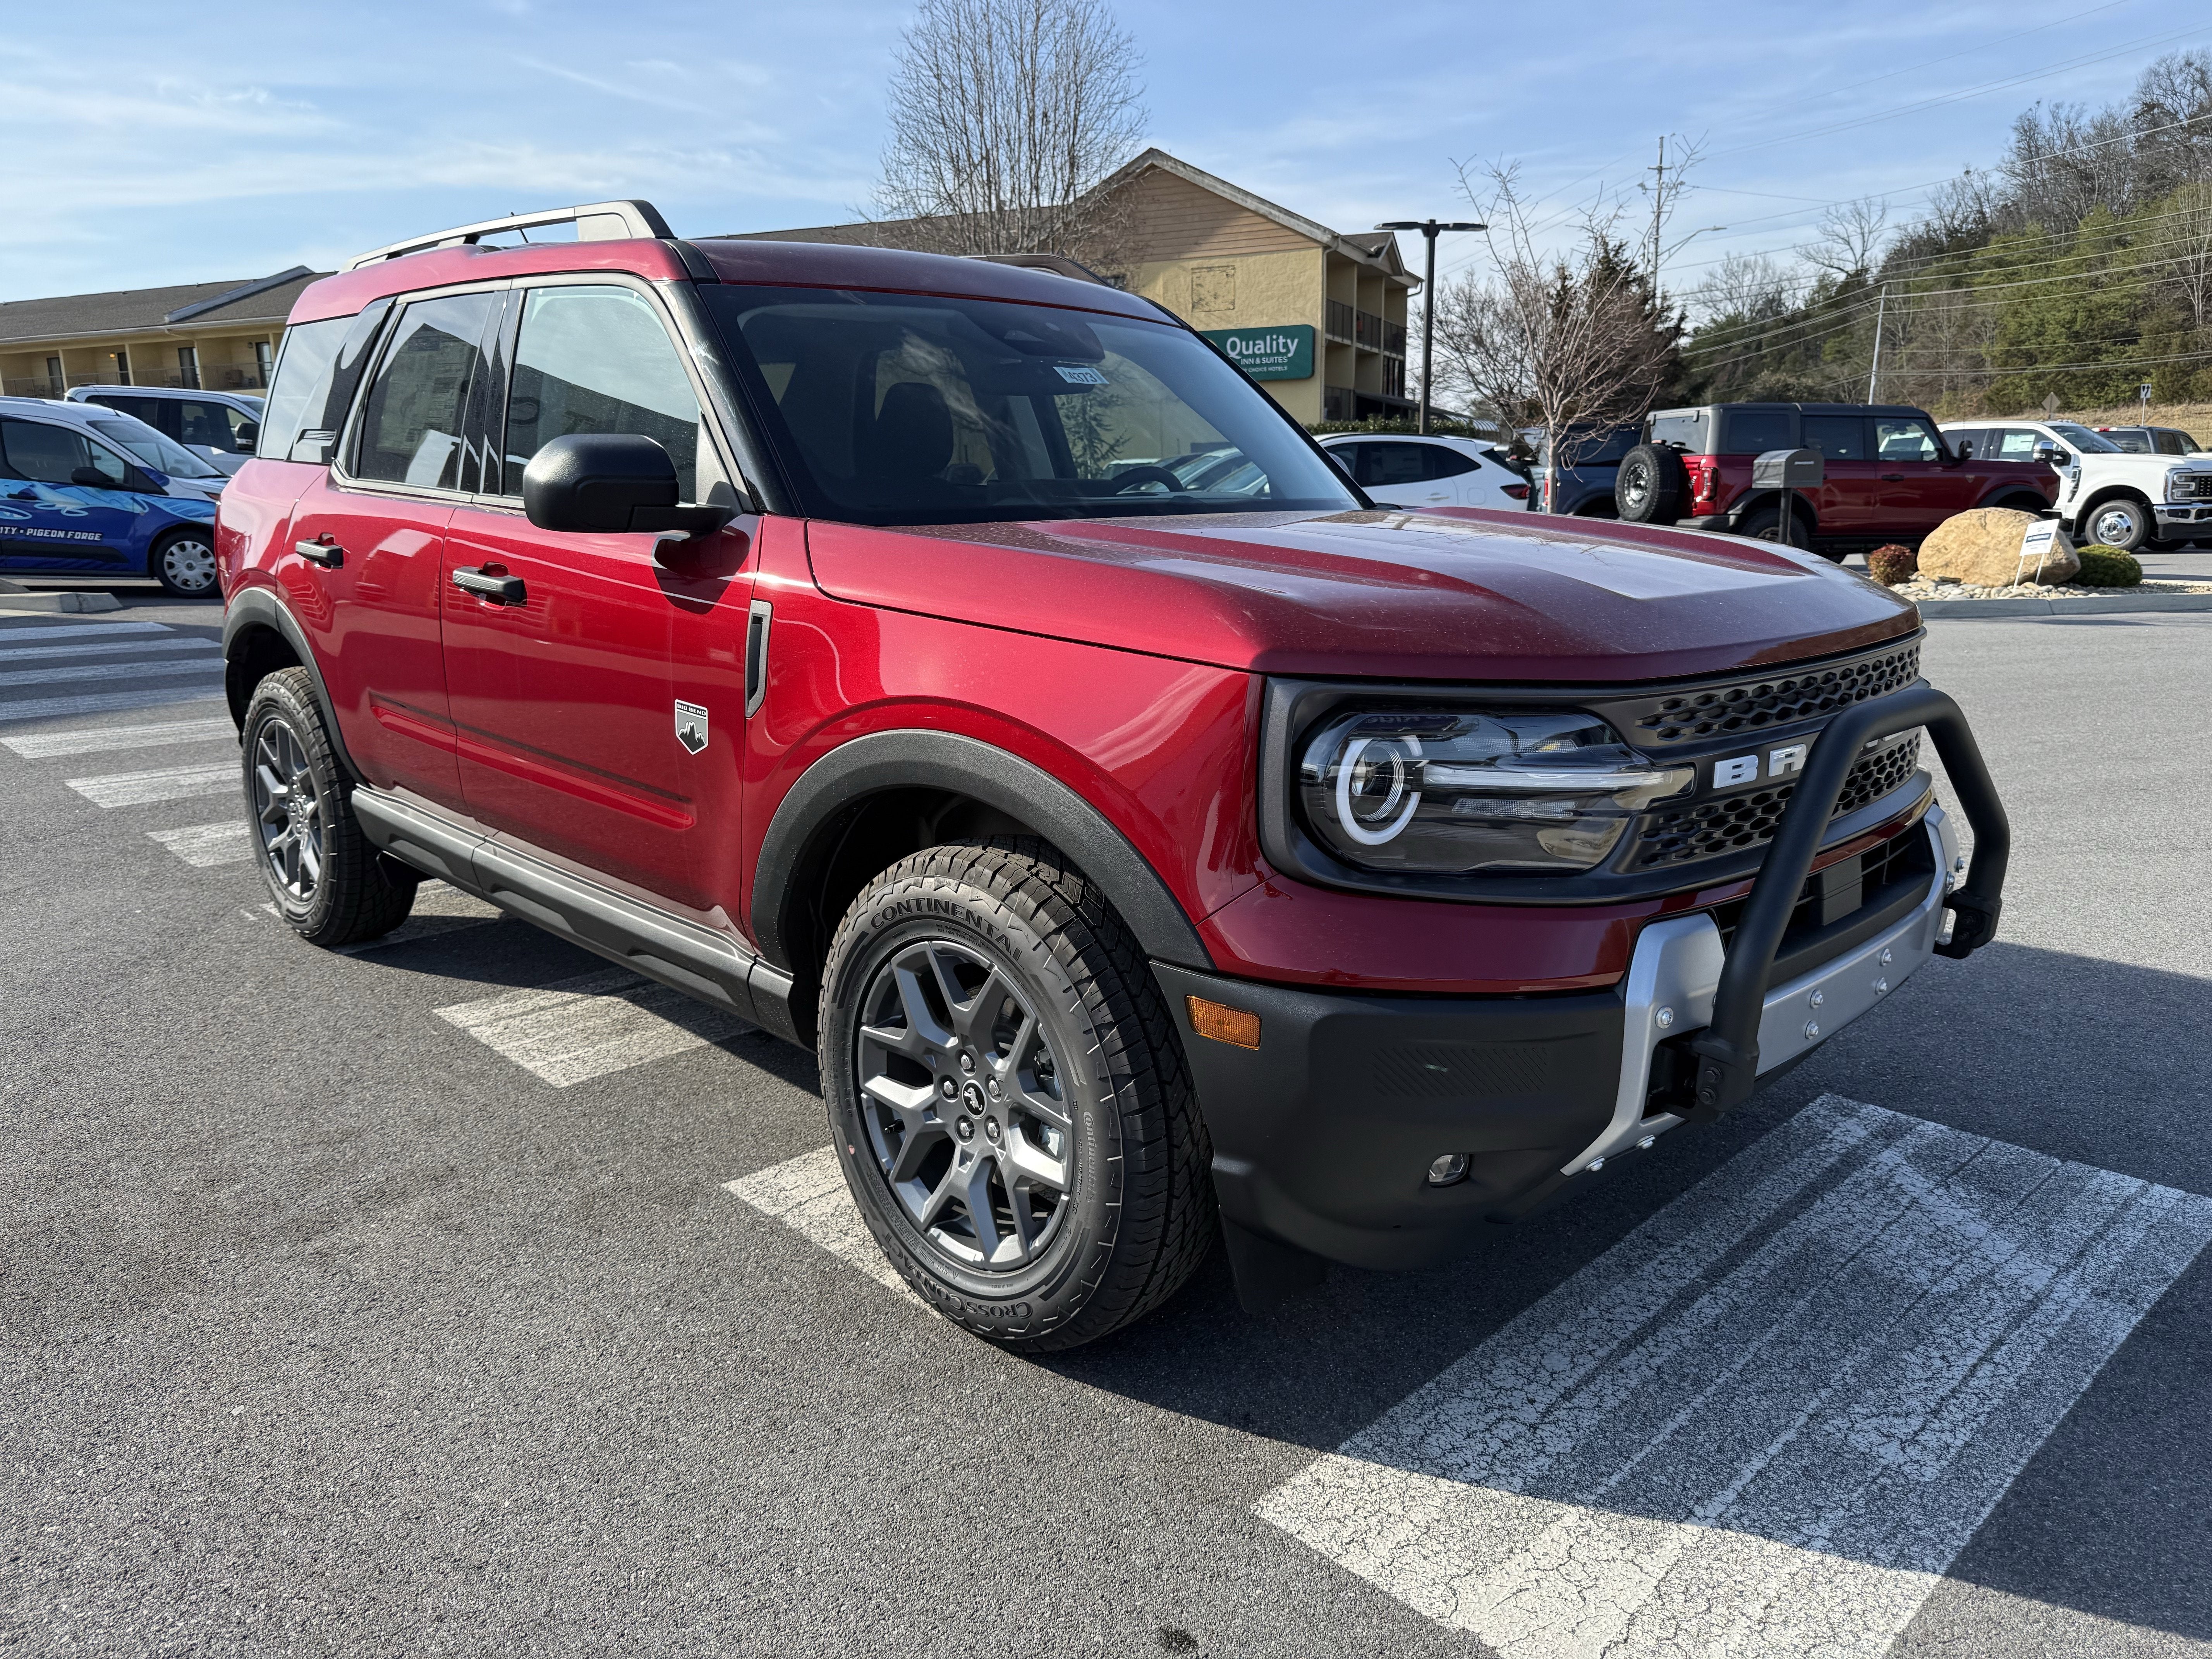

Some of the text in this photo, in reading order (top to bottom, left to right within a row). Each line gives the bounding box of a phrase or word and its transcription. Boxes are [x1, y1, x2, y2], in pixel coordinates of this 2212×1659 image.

[1226, 335, 1299, 359] Quality
[1068, 371, 1097, 382] 4373
[26, 528, 65, 538] PIGEON
[67, 531, 102, 541] FORGE
[689, 706, 706, 716] BEND
[871, 897, 1025, 970] CONTINENTAL
[1083, 1111, 1097, 1194] Continental
